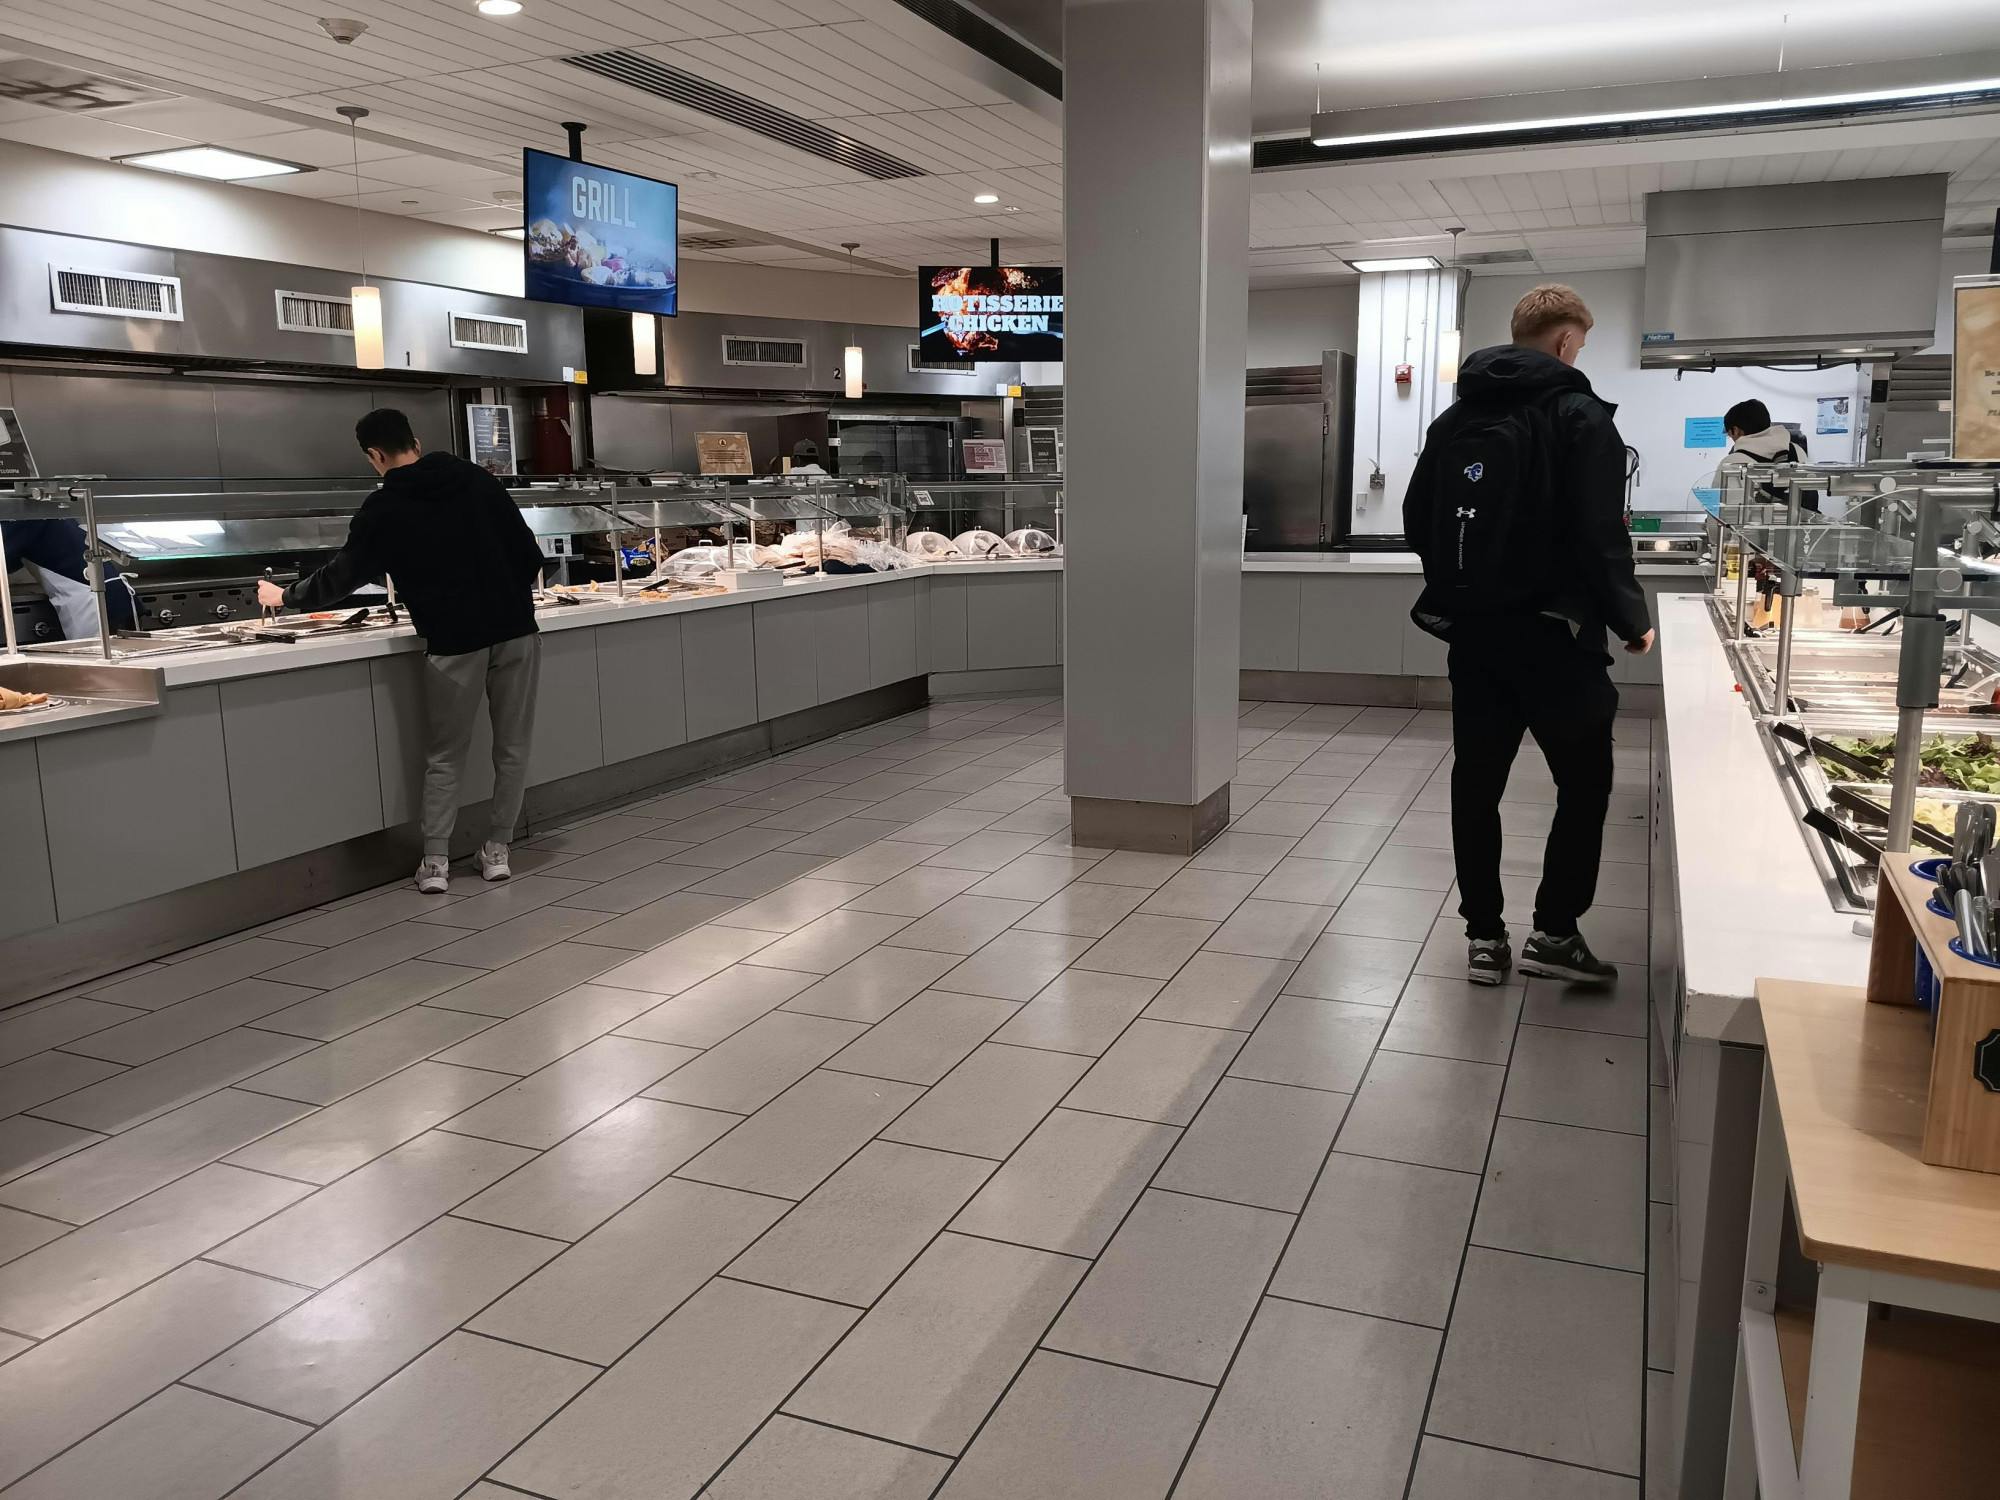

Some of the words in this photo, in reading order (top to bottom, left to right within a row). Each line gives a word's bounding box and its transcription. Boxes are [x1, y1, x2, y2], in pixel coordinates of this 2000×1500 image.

[572, 176, 636, 228] GRILL
[932, 295, 1063, 312] ROTISSERIE
[949, 315, 1049, 332] CHICKEN
[834, 367, 841, 380] 2
